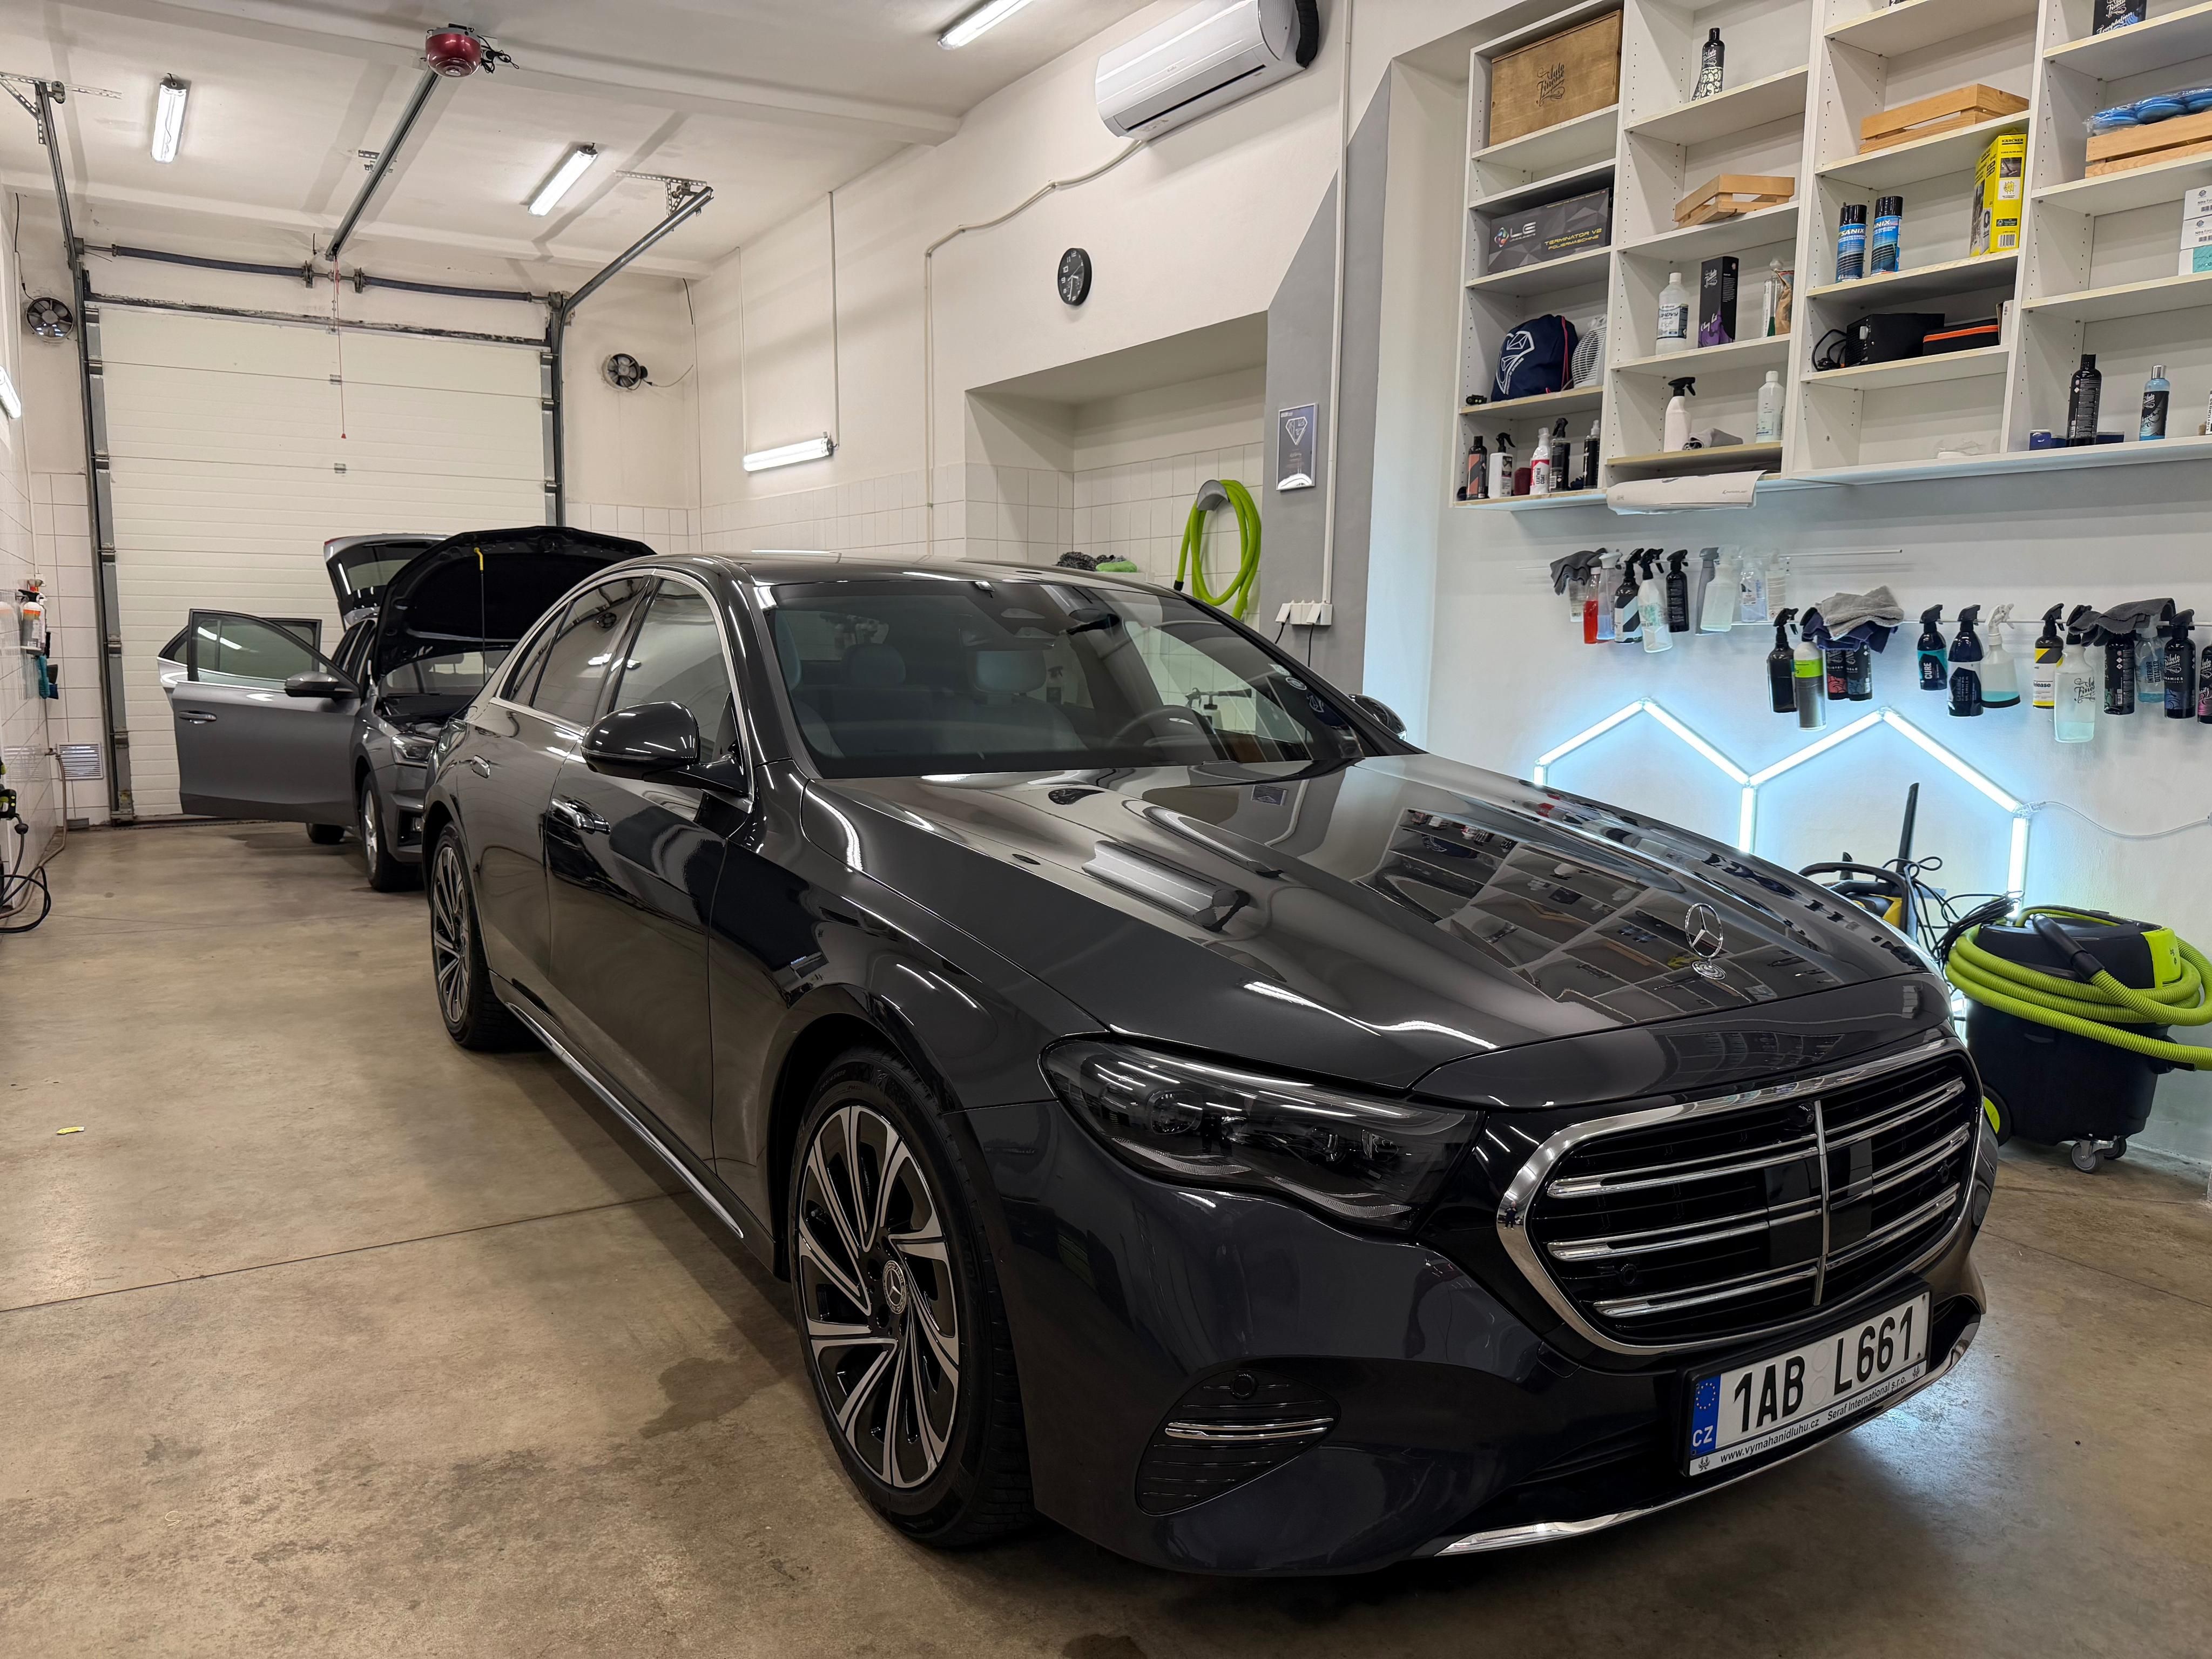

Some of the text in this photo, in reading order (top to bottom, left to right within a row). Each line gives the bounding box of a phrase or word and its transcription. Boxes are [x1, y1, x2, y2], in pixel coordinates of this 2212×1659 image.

[1545, 231, 1590, 246] TERMINATOR
[1840, 228, 1864, 237] SANIX
[1924, 663, 1933, 679] CURE
[2146, 662, 2154, 683] INTERIOR
[1734, 1305, 1913, 1432] 1AB L661
[1721, 1377, 1906, 1463] www.vymahanidluhu.cz Seraf International s.r.o.
[1692, 1425, 1714, 1447] CZ
